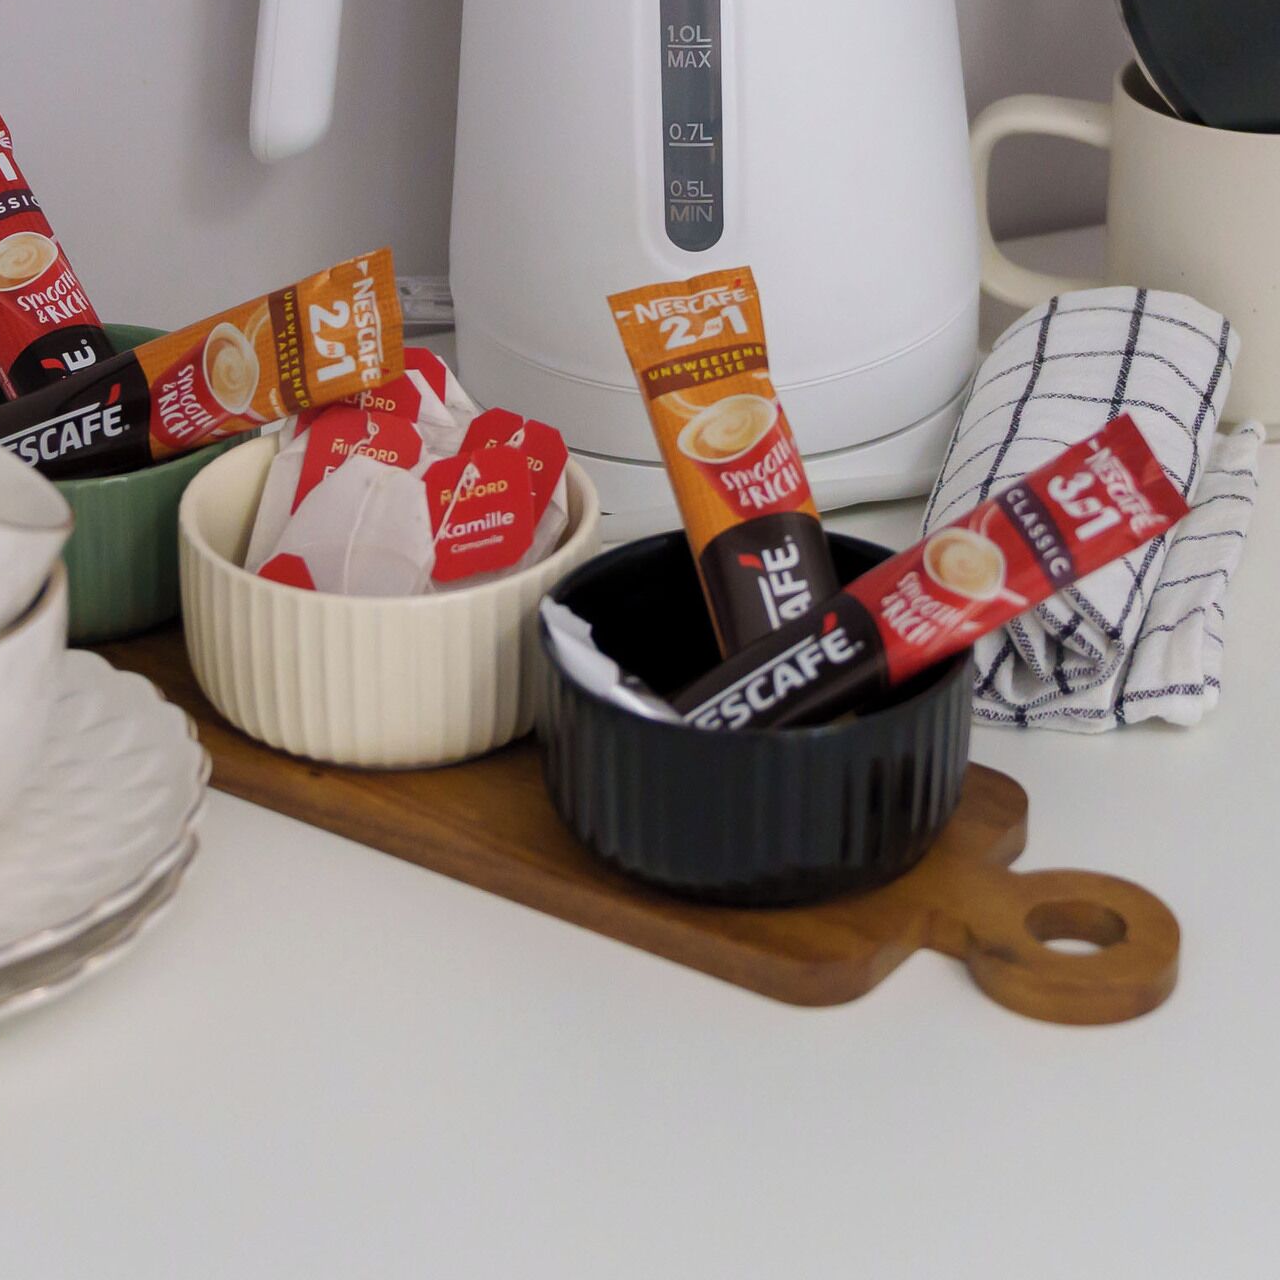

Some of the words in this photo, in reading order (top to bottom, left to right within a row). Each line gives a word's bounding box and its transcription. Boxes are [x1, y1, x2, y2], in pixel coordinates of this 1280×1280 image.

[666, 24, 713, 43] 1.0L
[667, 50, 712, 69] MAX
[669, 122, 713, 141] 0.7L
[670, 179, 713, 198] 0.5L
[670, 205, 713, 222] MIN
[633, 279, 748, 324] NESCAFÉ
[277, 331, 291, 382] TASTE
[283, 291, 310, 408] UNSWEETENED
[647, 345, 765, 381] UNSWEETENE
[691, 360, 746, 382] TASTE
[440, 480, 508, 505] MLFORD
[1005, 488, 1070, 577] CLASSIC
[689, 612, 856, 731] ESCAFÉ
